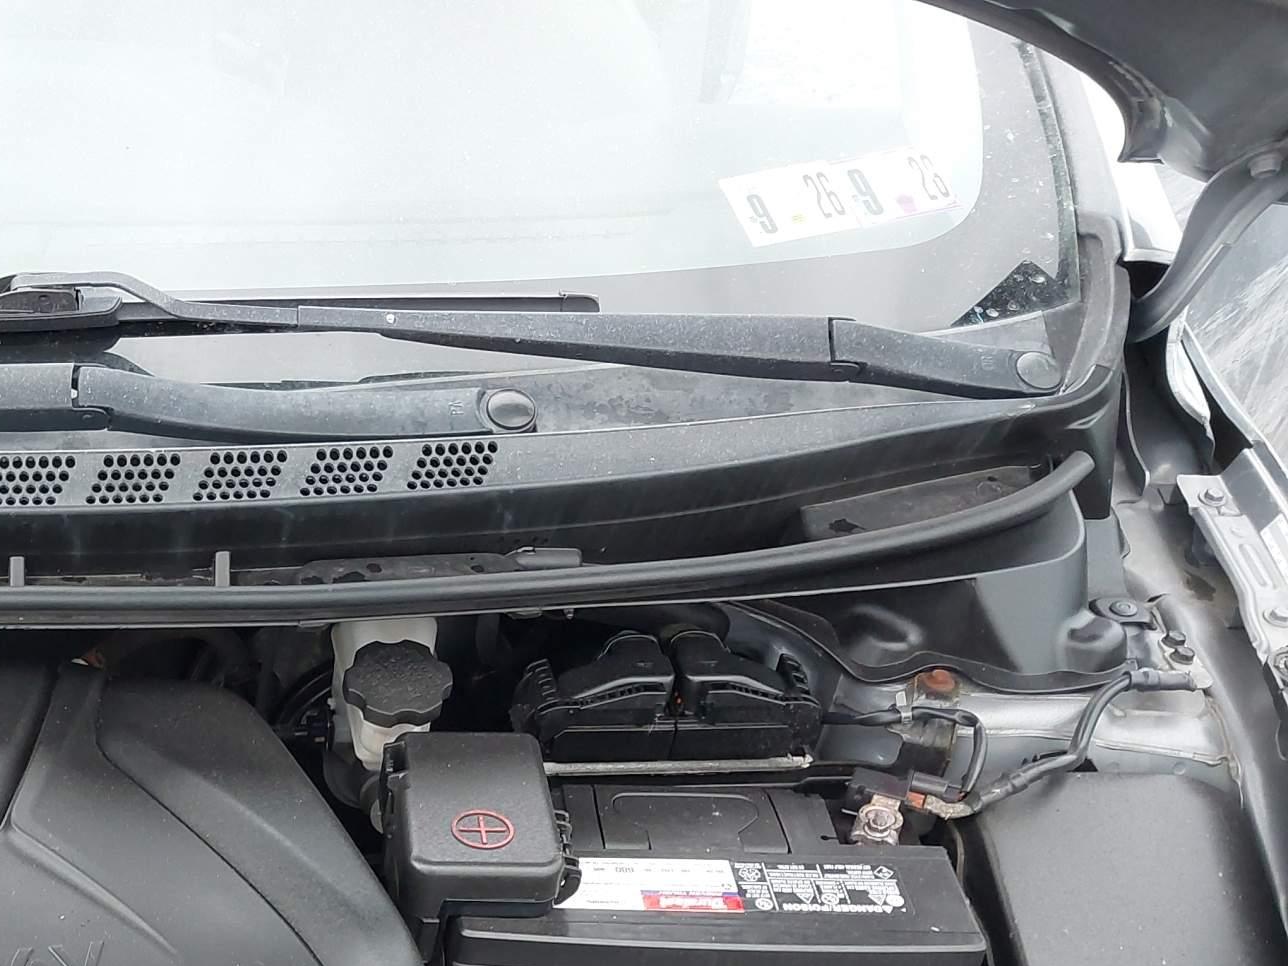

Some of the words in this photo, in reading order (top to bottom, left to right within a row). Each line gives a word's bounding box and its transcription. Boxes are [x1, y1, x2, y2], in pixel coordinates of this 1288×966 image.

[746, 193, 779, 235] 9
[802, 171, 846, 219] 26
[846, 168, 885, 216] 9
